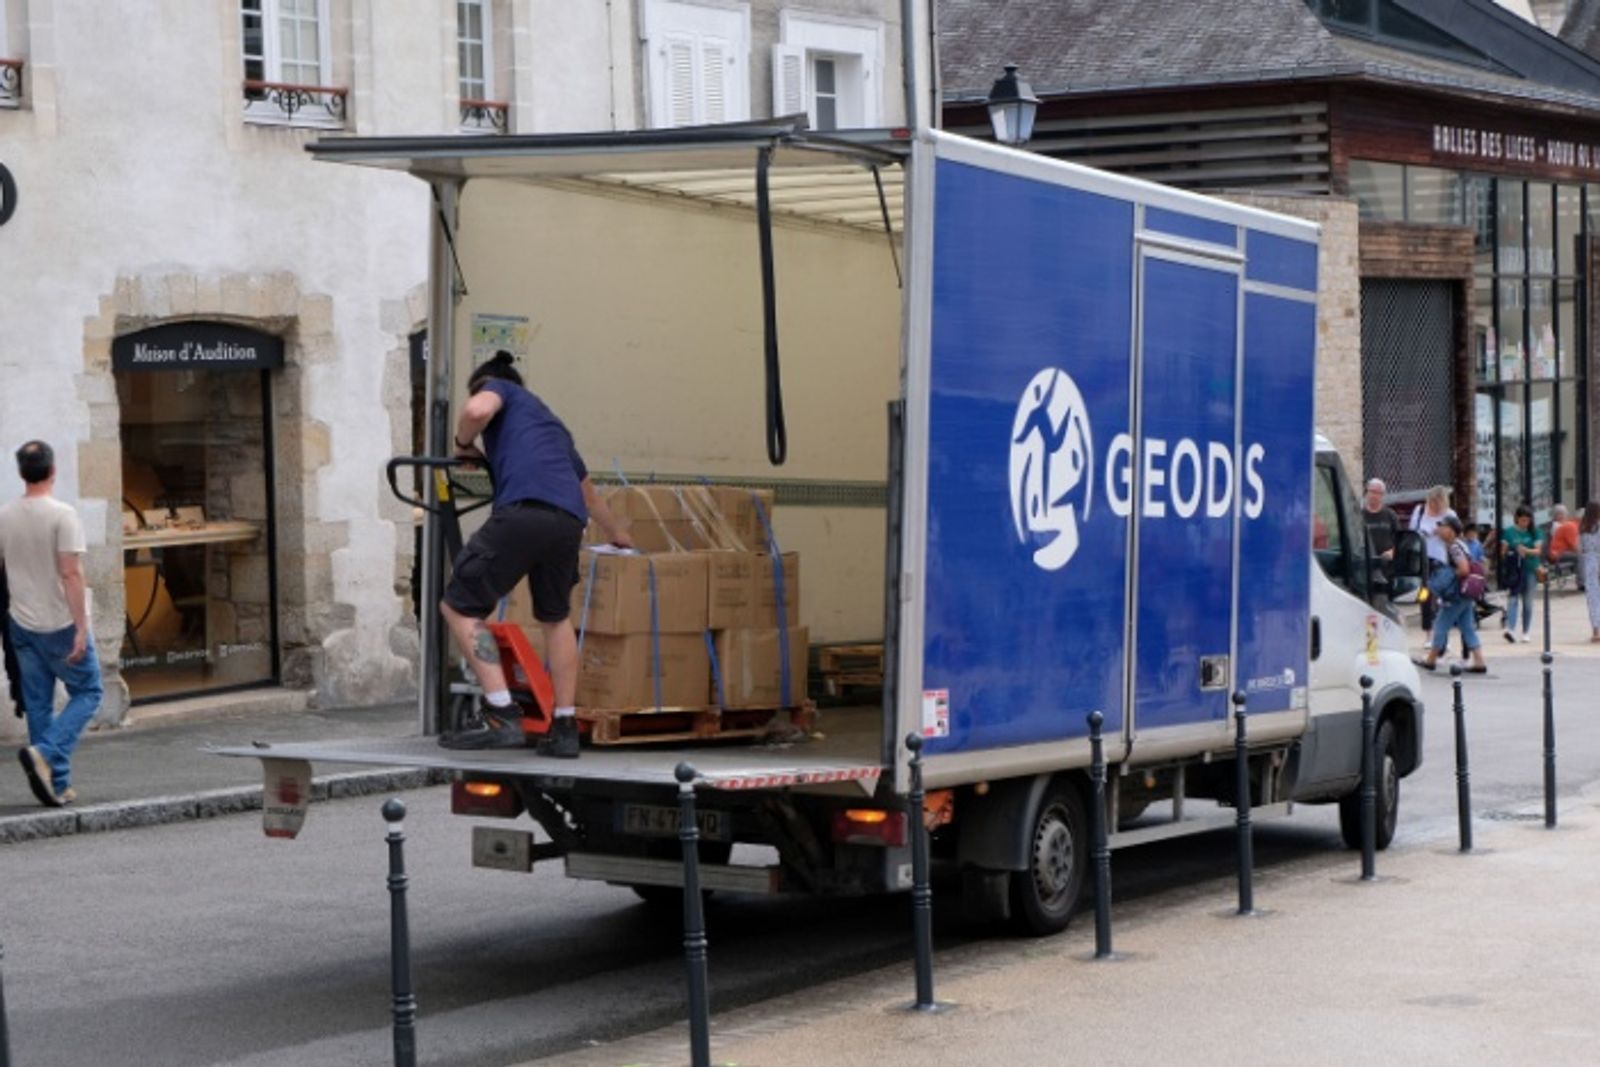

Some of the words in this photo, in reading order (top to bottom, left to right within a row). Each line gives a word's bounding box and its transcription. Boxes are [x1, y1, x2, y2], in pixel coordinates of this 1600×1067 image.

[1433, 124, 1477, 155] HALLES
[1481, 130, 1502, 158] DES
[132, 343, 177, 362] Maison
[178, 341, 258, 361] d'Audition
[1105, 432, 1266, 520] GEODIS
